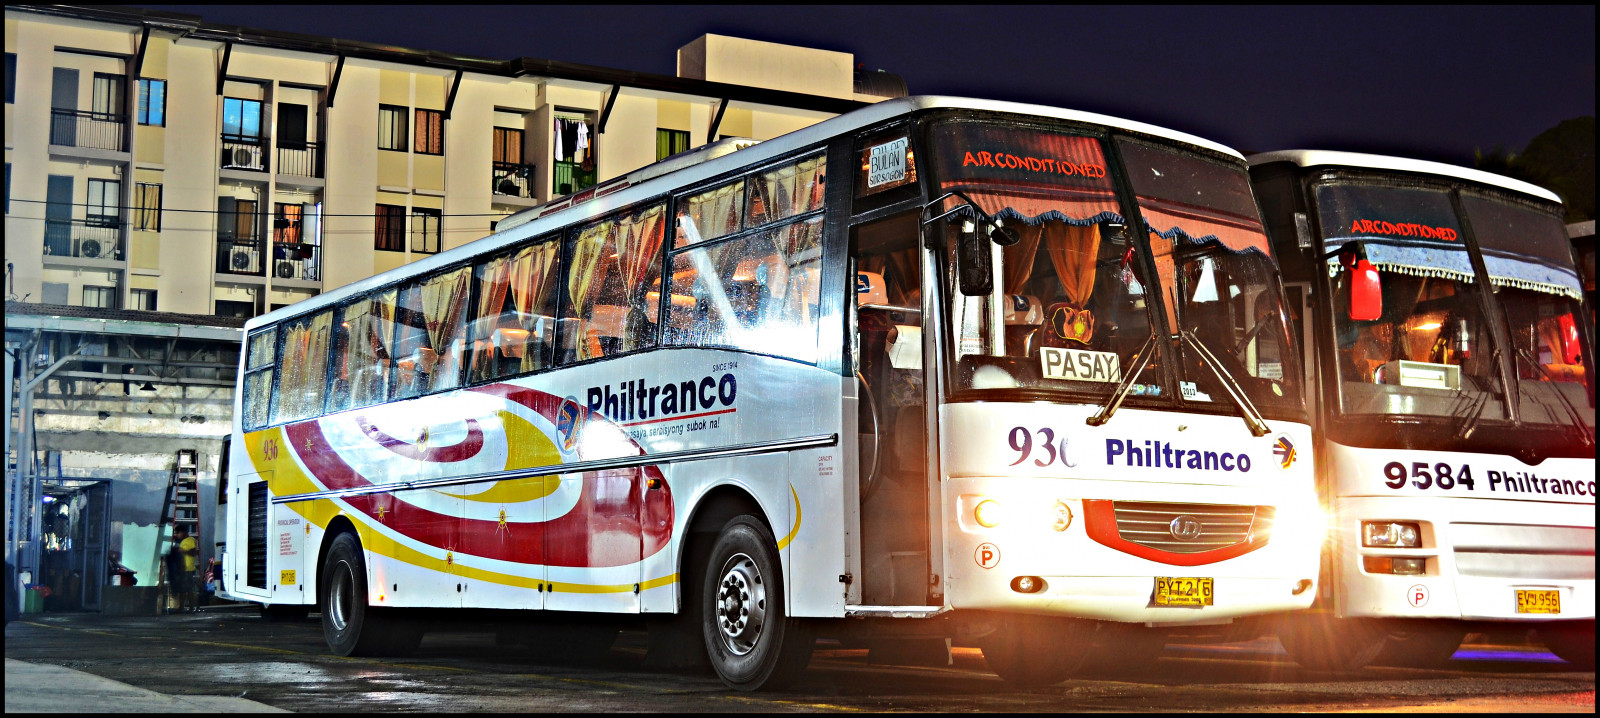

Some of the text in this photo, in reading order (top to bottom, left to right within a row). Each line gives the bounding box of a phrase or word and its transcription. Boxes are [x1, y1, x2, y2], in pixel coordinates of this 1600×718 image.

[871, 150, 900, 173] BULAN
[962, 150, 1106, 179] AIRCONDITIONED
[869, 168, 904, 185] SORSOGON
[1351, 218, 1457, 242] AIRCONDITIONED
[712, 362, 727, 373] SINCE
[1045, 349, 1115, 382] PASAY
[587, 373, 738, 422] Philtranco
[1182, 387, 1196, 396] 2013
[686, 419, 707, 432] subok
[709, 417, 720, 429] na!
[263, 437, 279, 462] 936
[1105, 438, 1251, 473] Philtranco
[1383, 461, 1475, 491] 9584
[1487, 470, 1595, 497] Philtranco
[982, 550, 993, 566] P
[1415, 592, 1424, 605] P
